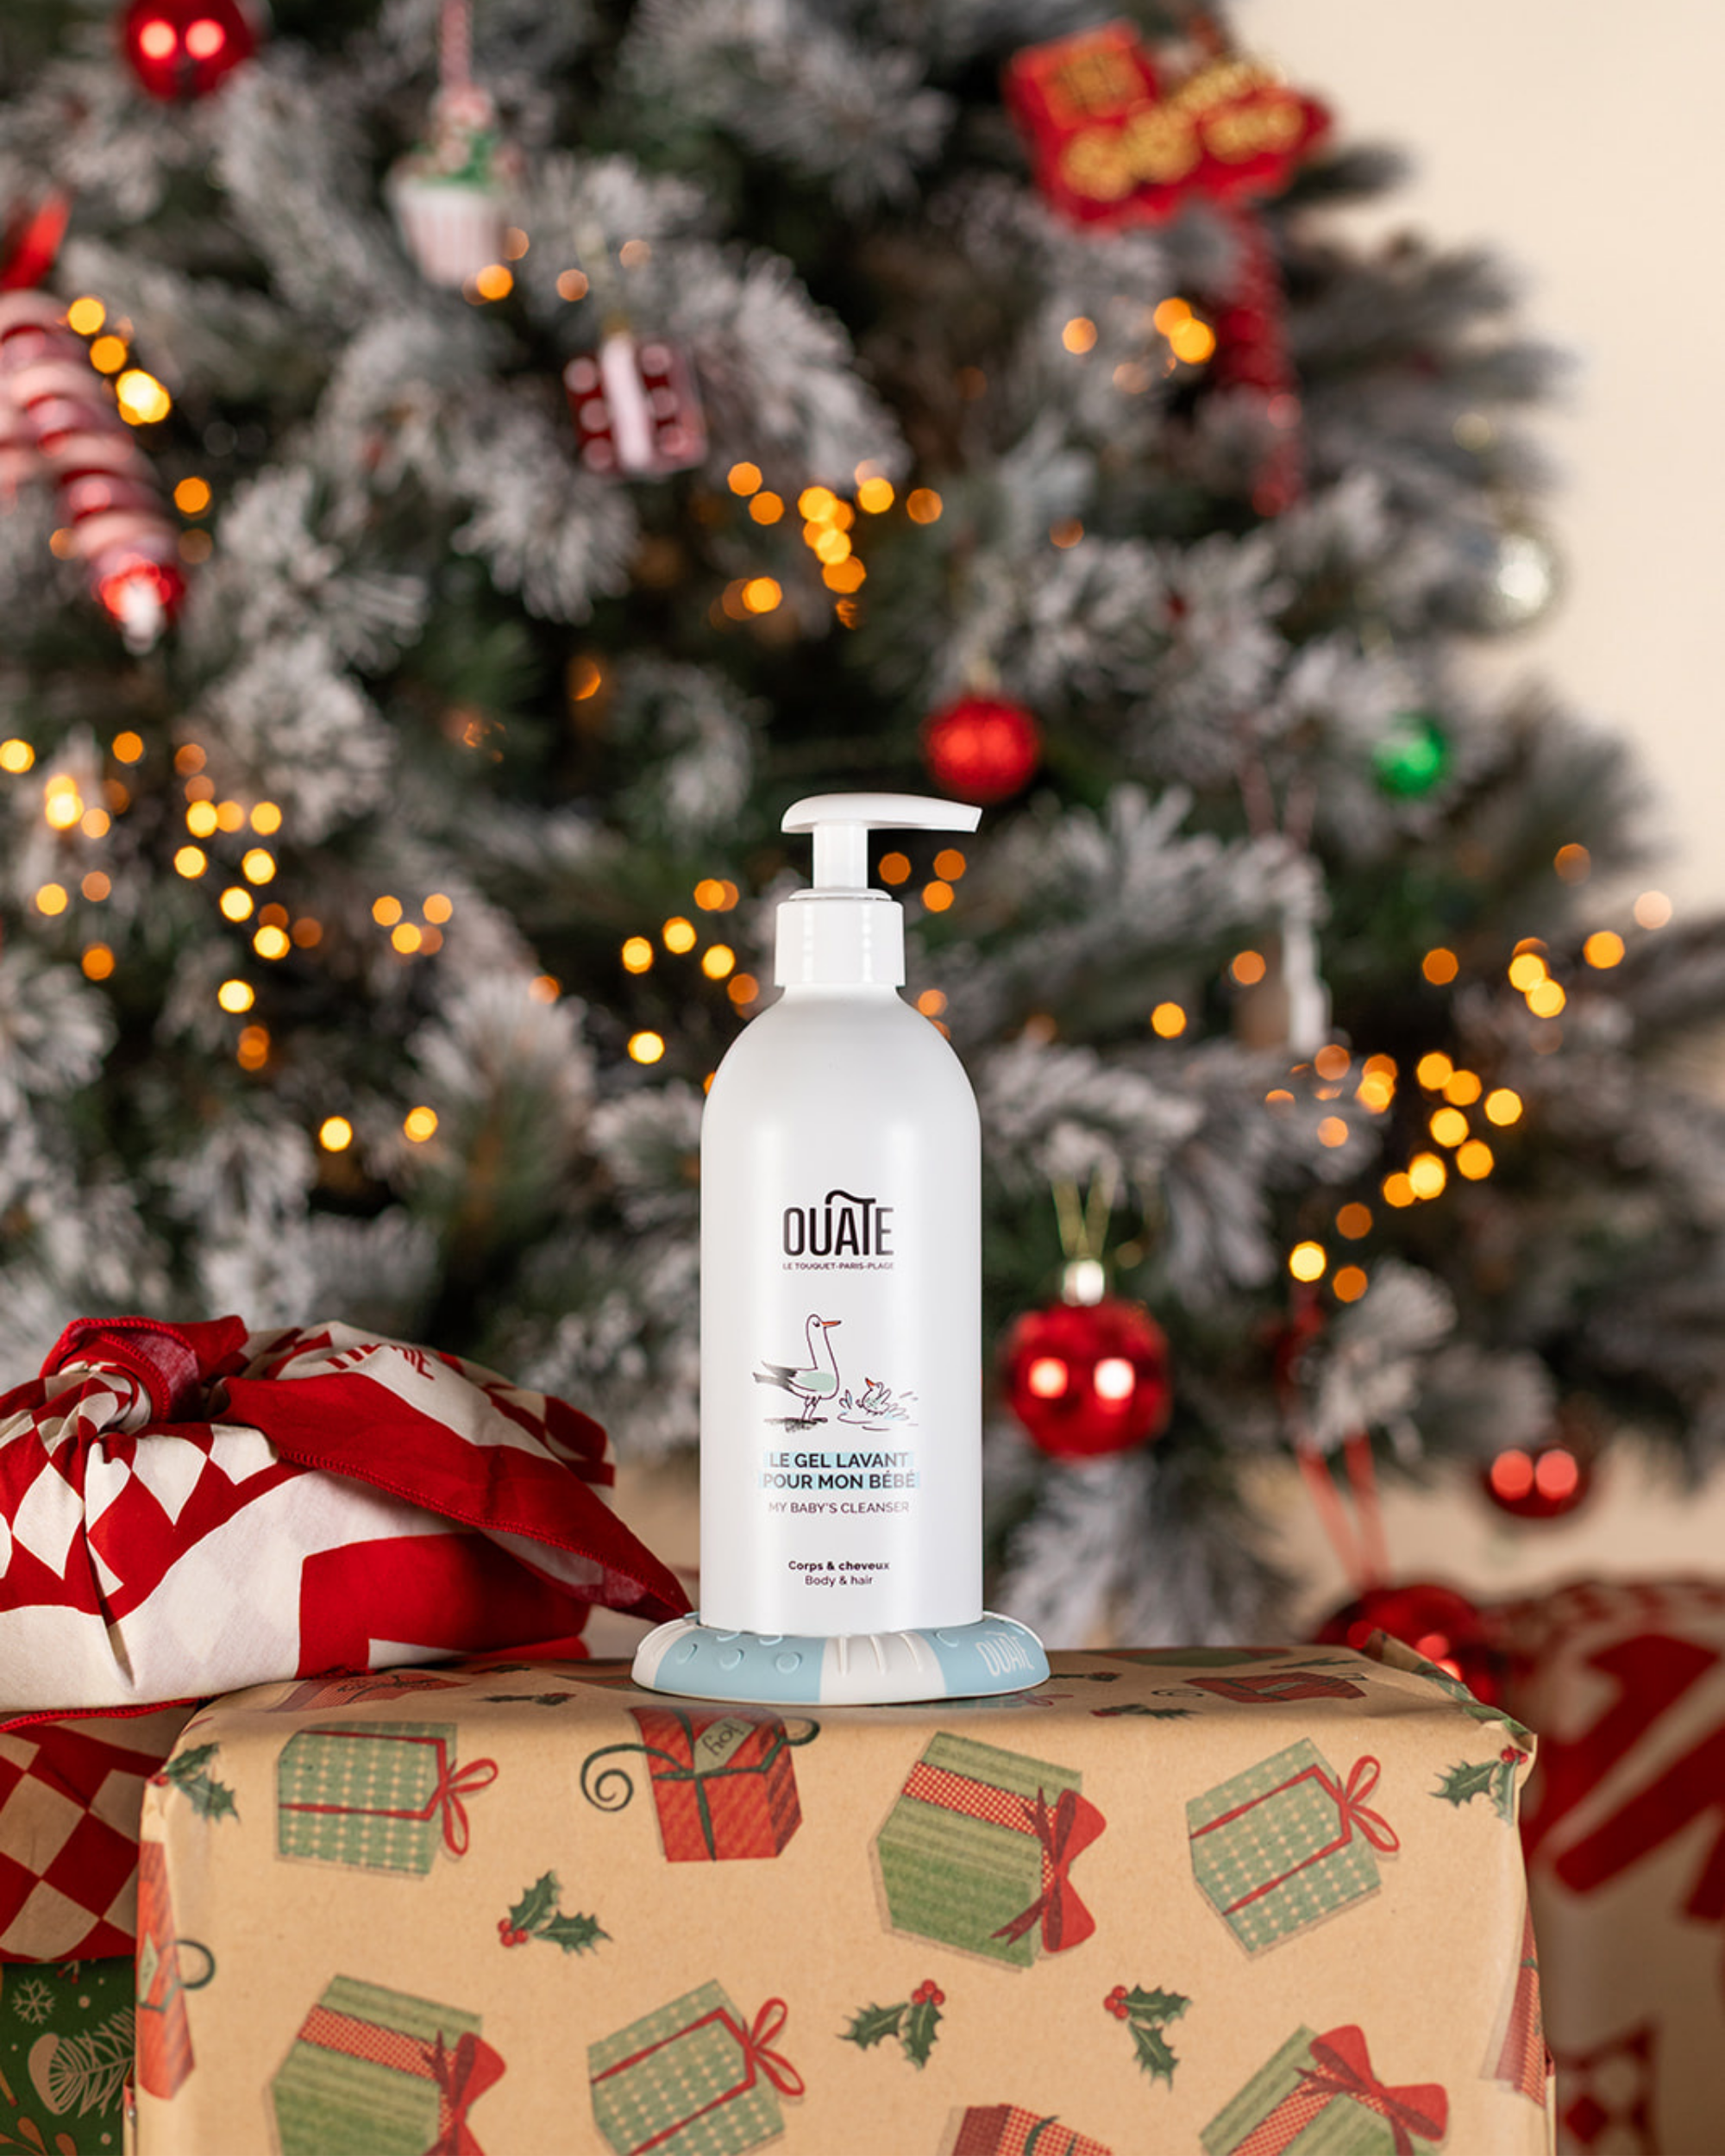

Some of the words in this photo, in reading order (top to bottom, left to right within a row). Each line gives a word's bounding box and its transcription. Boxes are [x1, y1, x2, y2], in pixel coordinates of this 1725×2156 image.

[782, 1262, 794, 1270] LE
[794, 1262, 894, 1270] TOUQUET-PARIS-PLAGE
[768, 1452, 790, 1468] LE
[794, 1452, 831, 1468] GEL
[836, 1452, 909, 1468] LAVANT
[762, 1473, 813, 1489] POUR
[818, 1473, 862, 1489] MON
[869, 1469, 916, 1489] BÉBÉ
[768, 1501, 788, 1514] MY
[789, 1501, 837, 1514] BABY'S
[840, 1501, 909, 1514] CLEANSER
[787, 1560, 823, 1573] Corps
[826, 1561, 835, 1571] &
[837, 1560, 890, 1571] cheveux
[805, 1575, 836, 1588] Body
[838, 1576, 848, 1586] &
[850, 1575, 874, 1586] hair
